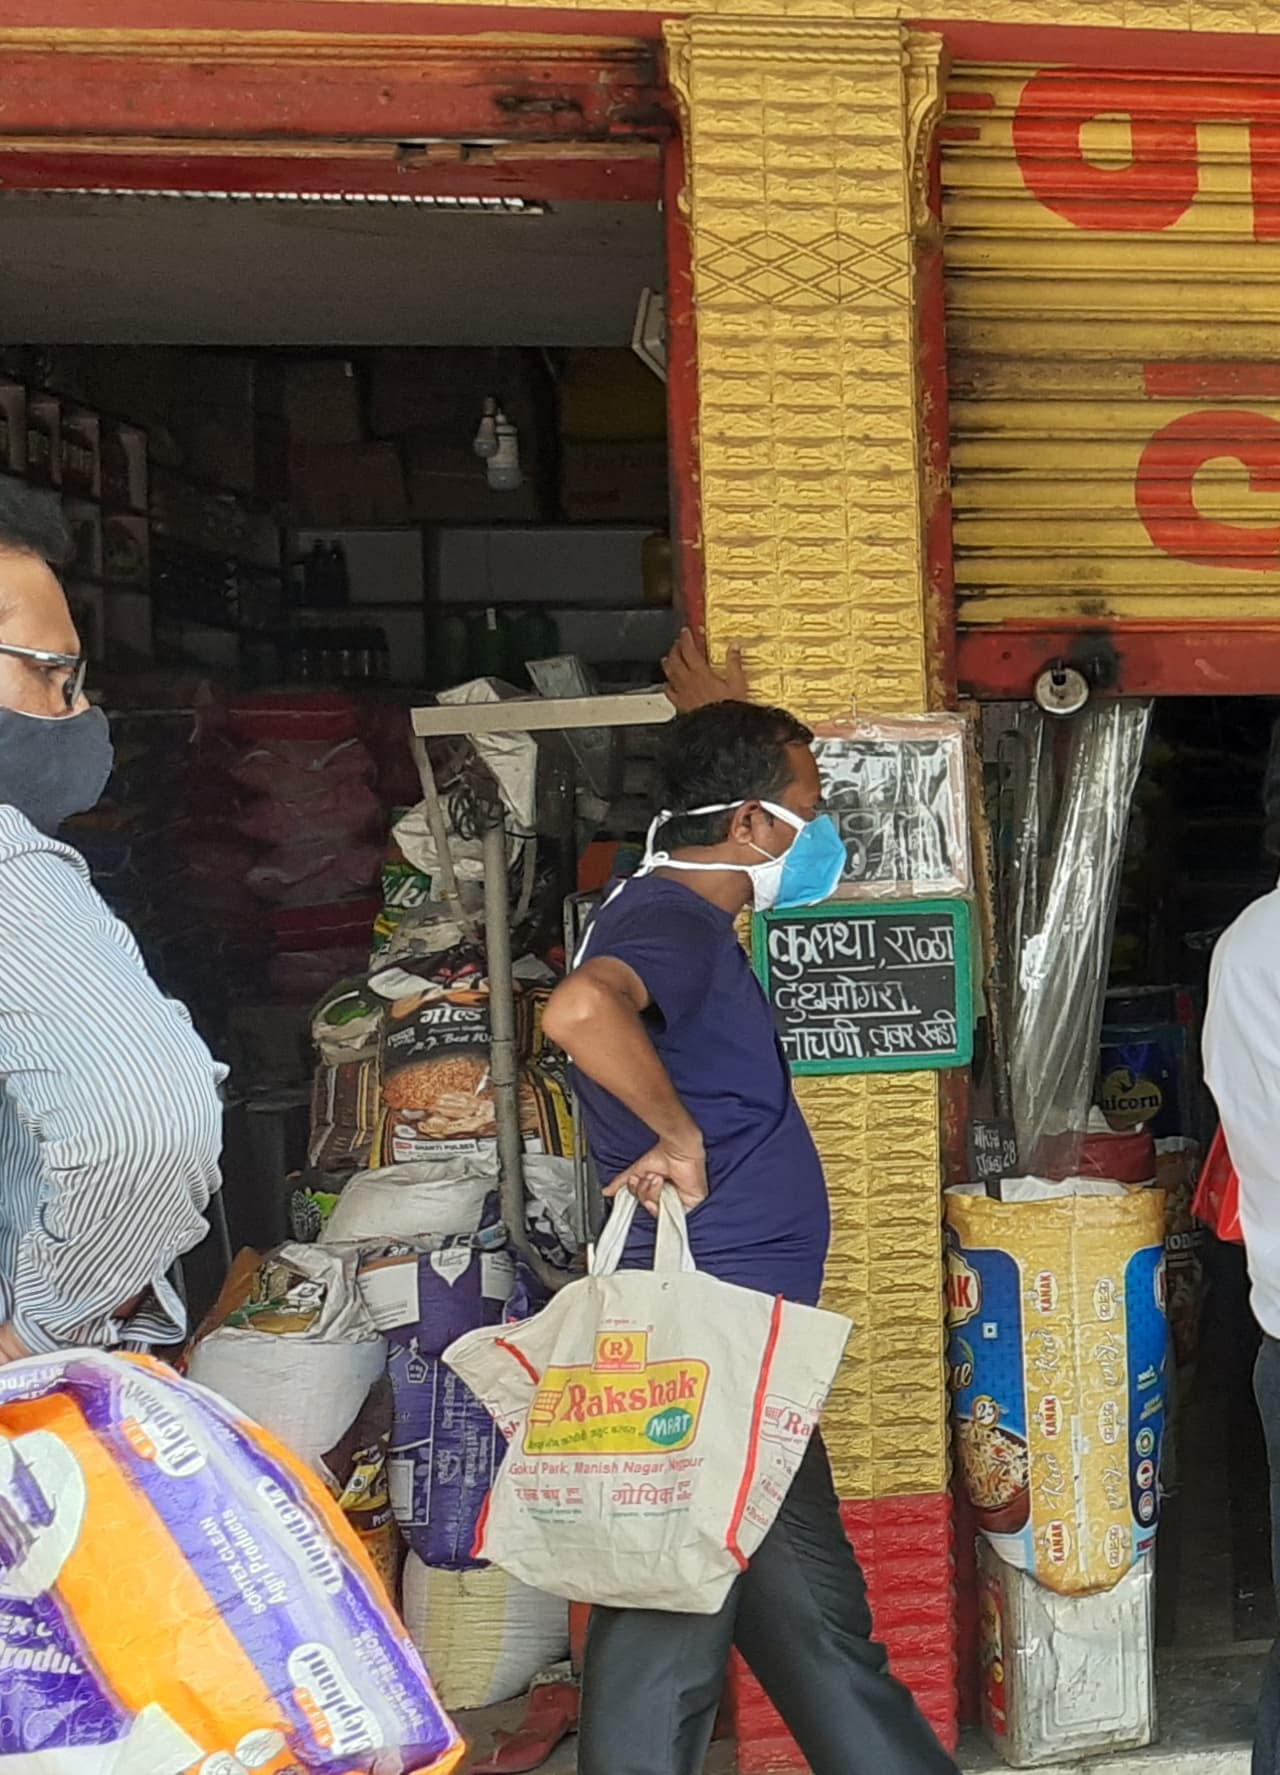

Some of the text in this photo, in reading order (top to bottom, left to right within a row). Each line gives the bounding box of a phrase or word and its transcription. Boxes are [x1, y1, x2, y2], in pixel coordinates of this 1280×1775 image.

[420, 1002, 487, 1024] गोल्ड
[1098, 1094, 1160, 1112] nicorn
[1040, 1273, 1052, 1313] KANAK
[608, 1340, 624, 1356] R
[560, 1369, 699, 1423] Rakshak
[649, 1414, 691, 1438] MART
[1044, 1395, 1057, 1438] KANAK
[509, 1461, 537, 1475] Gokul
[574, 1460, 619, 1475] Manish
[221, 1508, 265, 1574] Products
[1052, 1522, 1066, 1563] KANAK
[200, 1516, 267, 1616] SORTEX CLEAN
